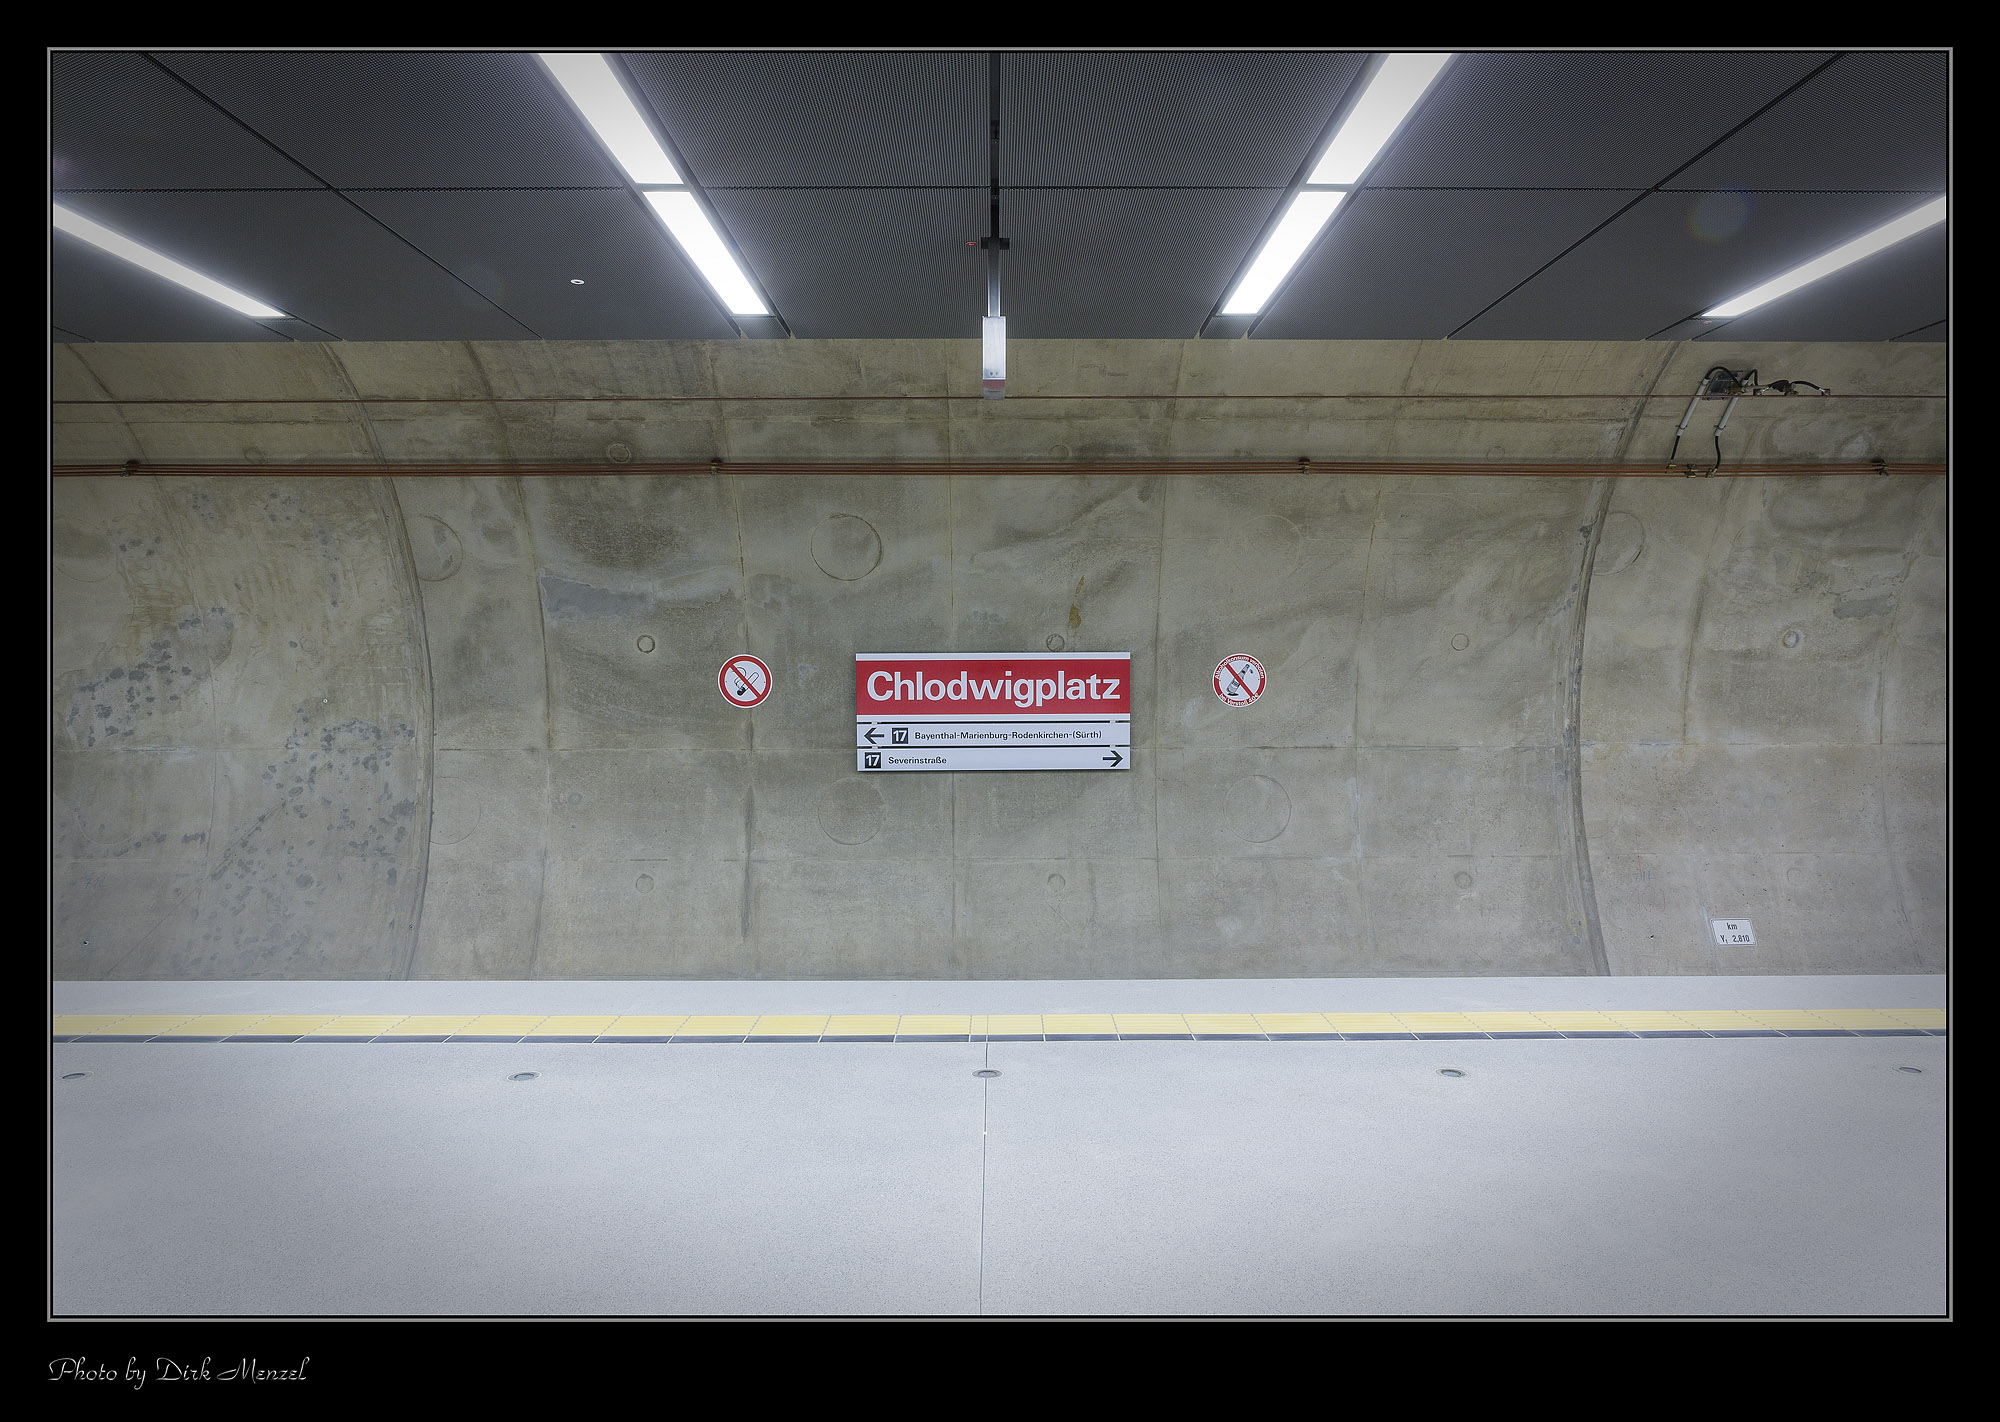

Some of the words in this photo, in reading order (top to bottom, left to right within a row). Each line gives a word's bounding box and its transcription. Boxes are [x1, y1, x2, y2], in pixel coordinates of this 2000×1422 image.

[1249, 659, 1265, 679] verboten
[867, 670, 1121, 708] Chlodwigplatz
[892, 729, 908, 743] 17
[914, 731, 1102, 741] Bayenthal-Marienburg-Rodenkirchen-(Sürth)
[865, 753, 880, 767] 17
[888, 756, 947, 765] Severinstraße
[1726, 922, 1738, 930] km
